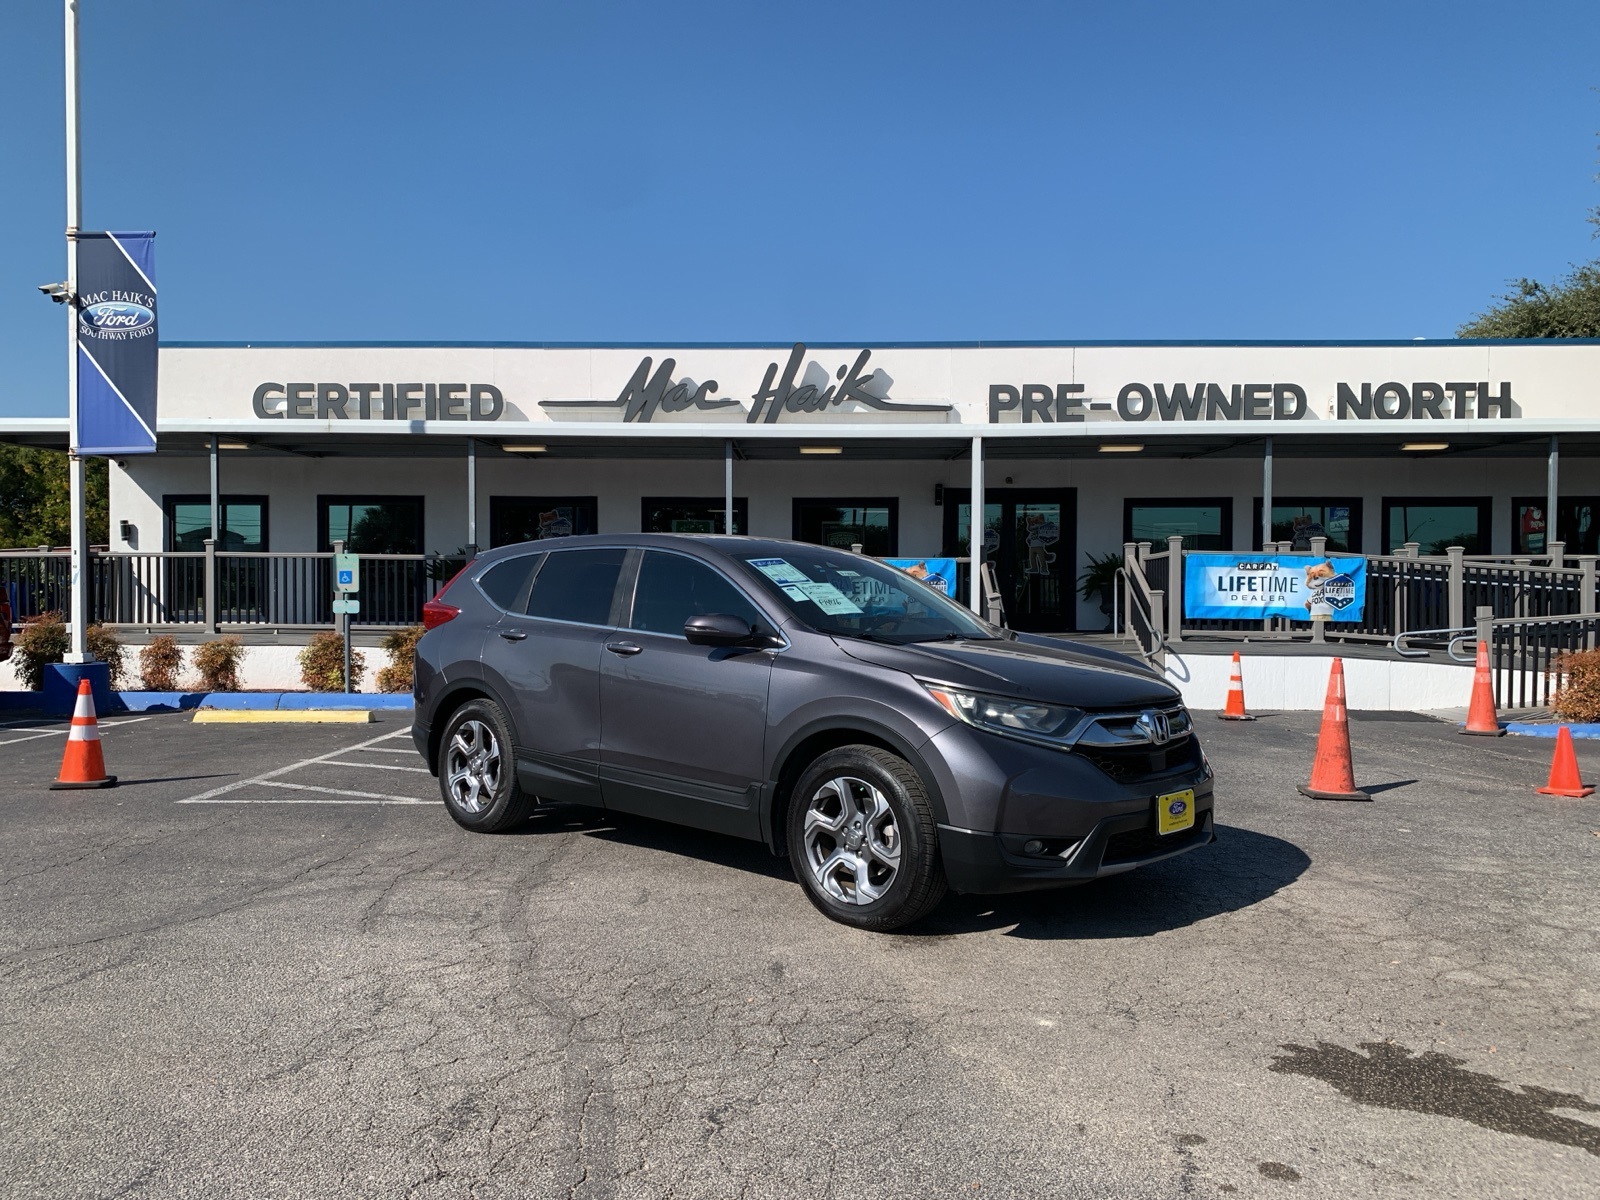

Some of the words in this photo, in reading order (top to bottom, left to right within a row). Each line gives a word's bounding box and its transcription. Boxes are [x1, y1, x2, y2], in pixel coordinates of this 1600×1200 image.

[80, 290, 108, 307] MAC
[112, 290, 154, 308] HAIK'S
[93, 306, 140, 326] Ford
[80, 325, 127, 340] SOUTHWAY
[129, 326, 155, 340] FORD
[252, 382, 504, 421] CERTIFIED
[746, 342, 953, 423] Haik
[988, 382, 1308, 423] PRE-OWNED
[1336, 381, 1512, 420] NORTH
[1238, 563, 1278, 571] CARFAX
[1218, 576, 1299, 593] LIFETIME
[1231, 594, 1286, 602] DEALER
